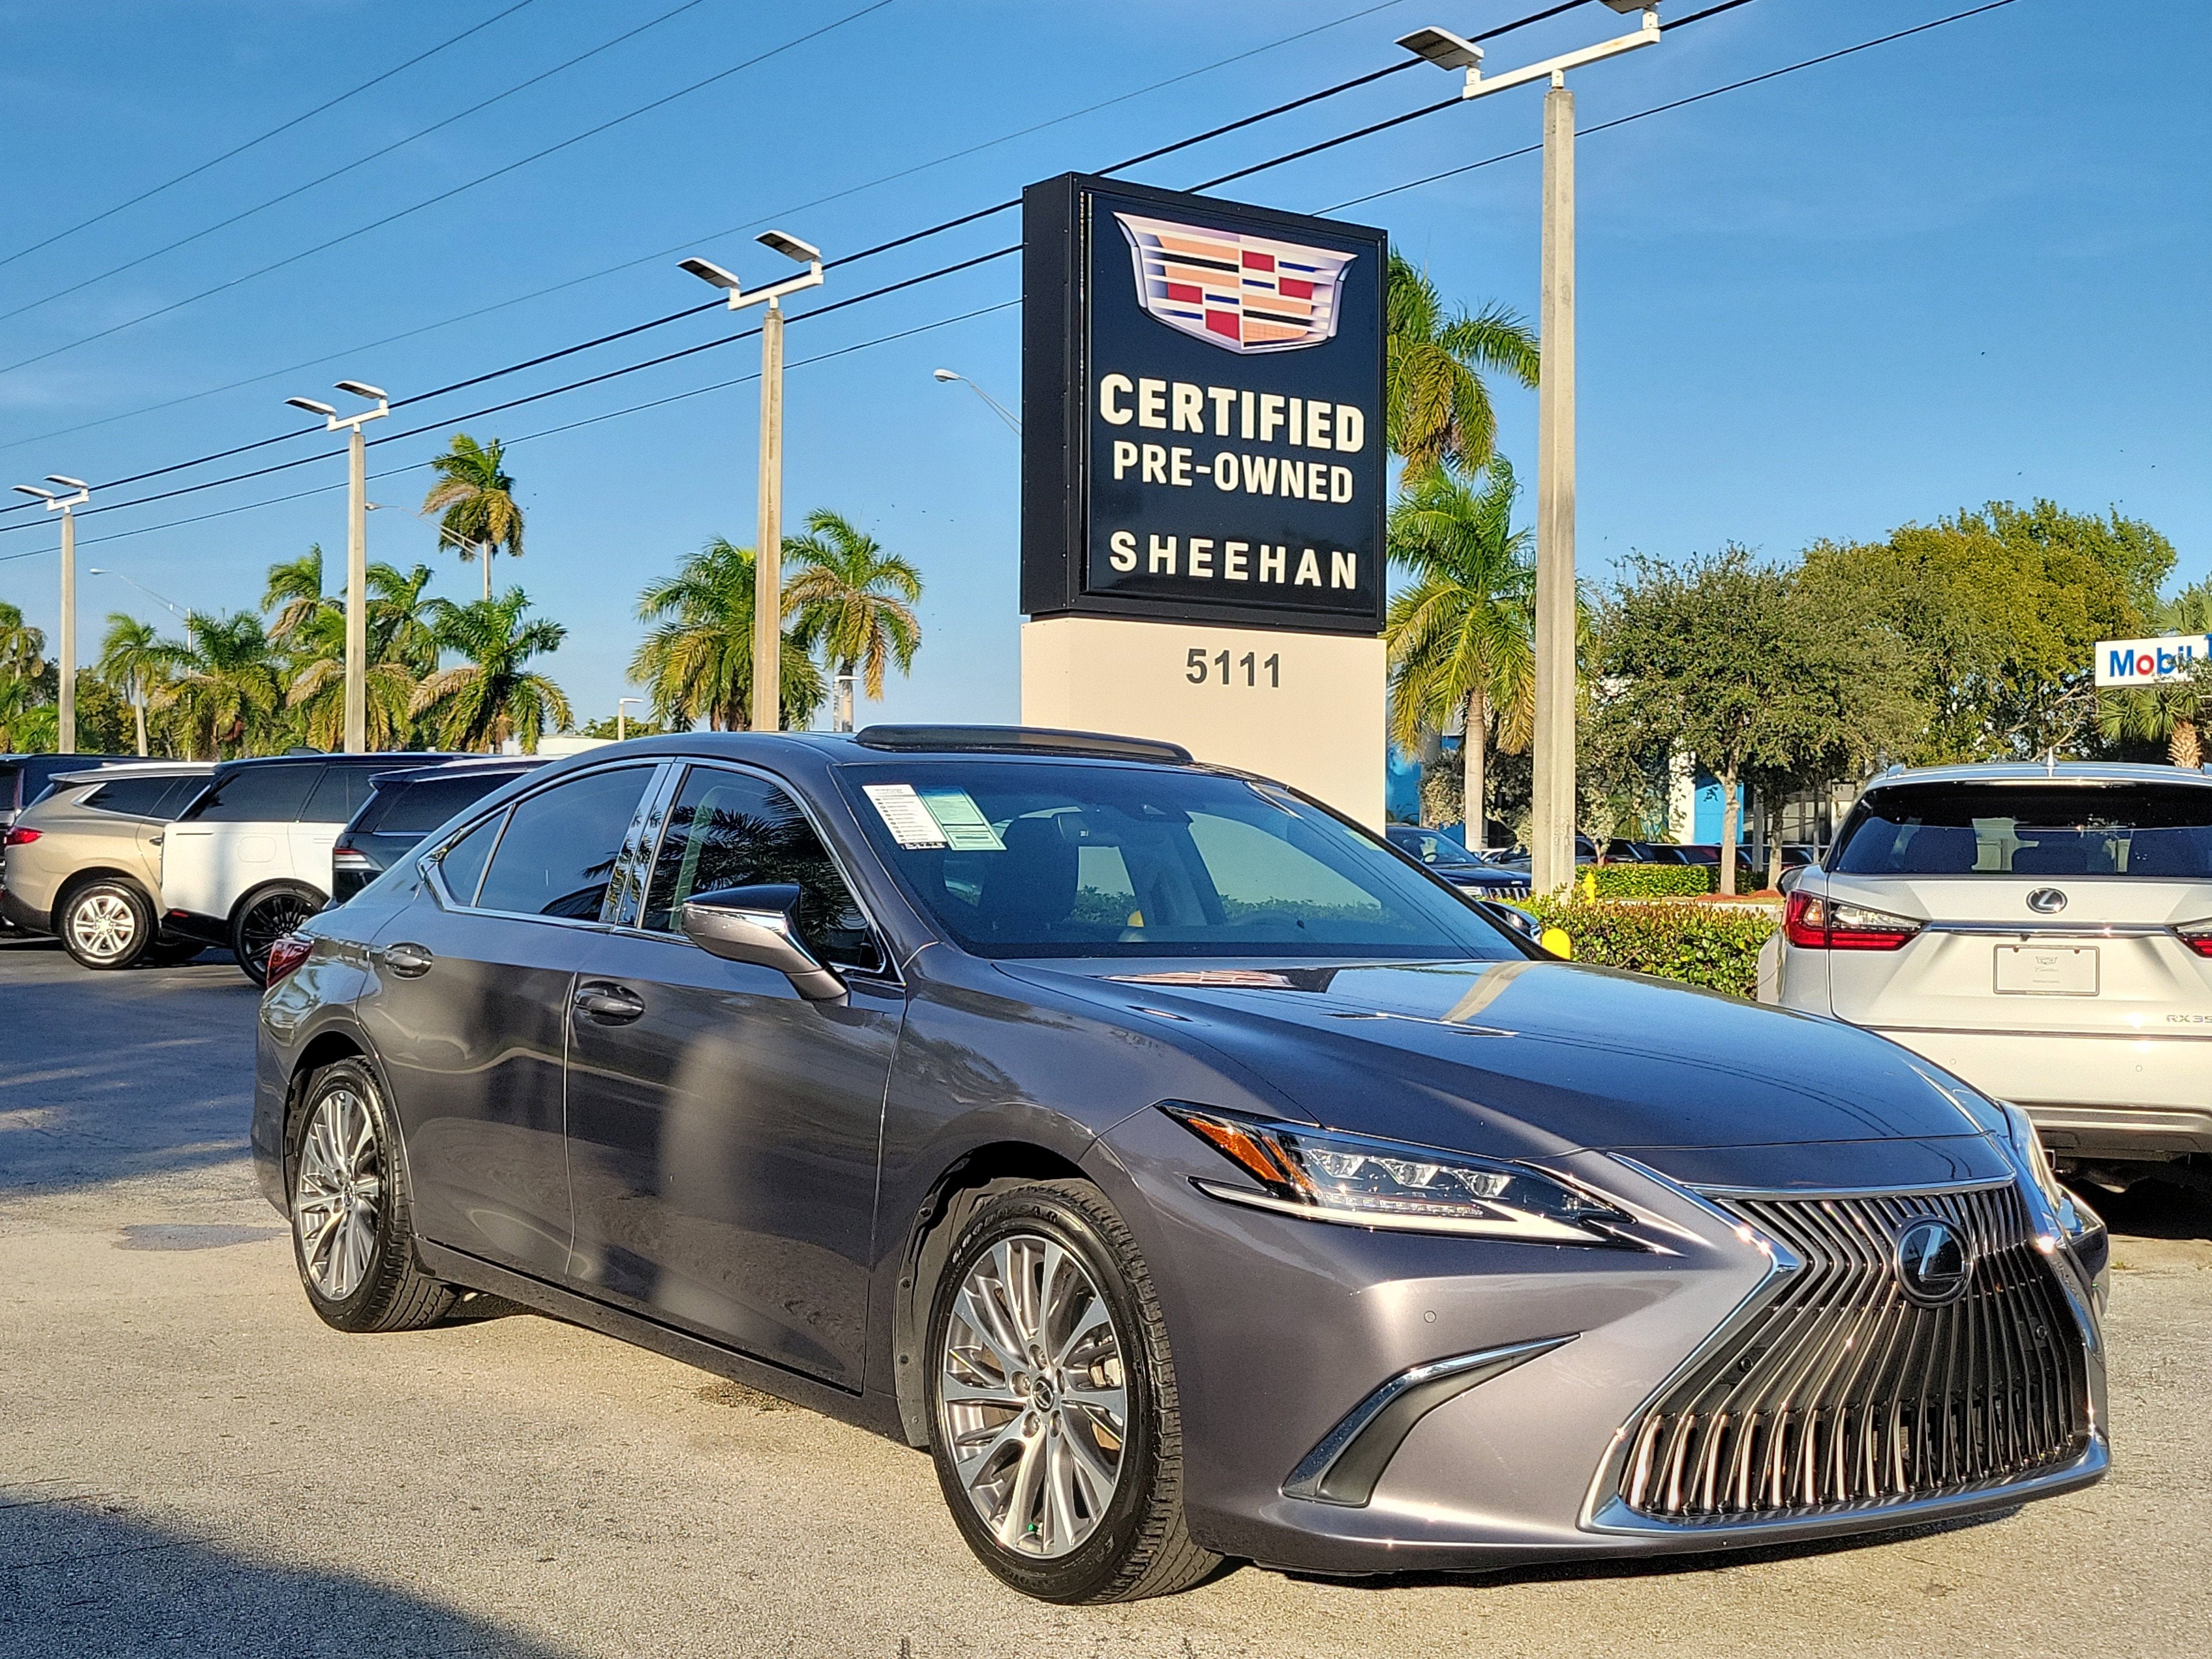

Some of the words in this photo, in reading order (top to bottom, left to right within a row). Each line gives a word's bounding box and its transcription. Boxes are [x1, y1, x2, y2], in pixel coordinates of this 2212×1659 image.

[1099, 374, 1364, 453] CERTIFIED
[1113, 441, 1353, 503] PRE-OWNED
[1109, 531, 1357, 590] SHEEHAN
[1185, 648, 1280, 688] 5111
